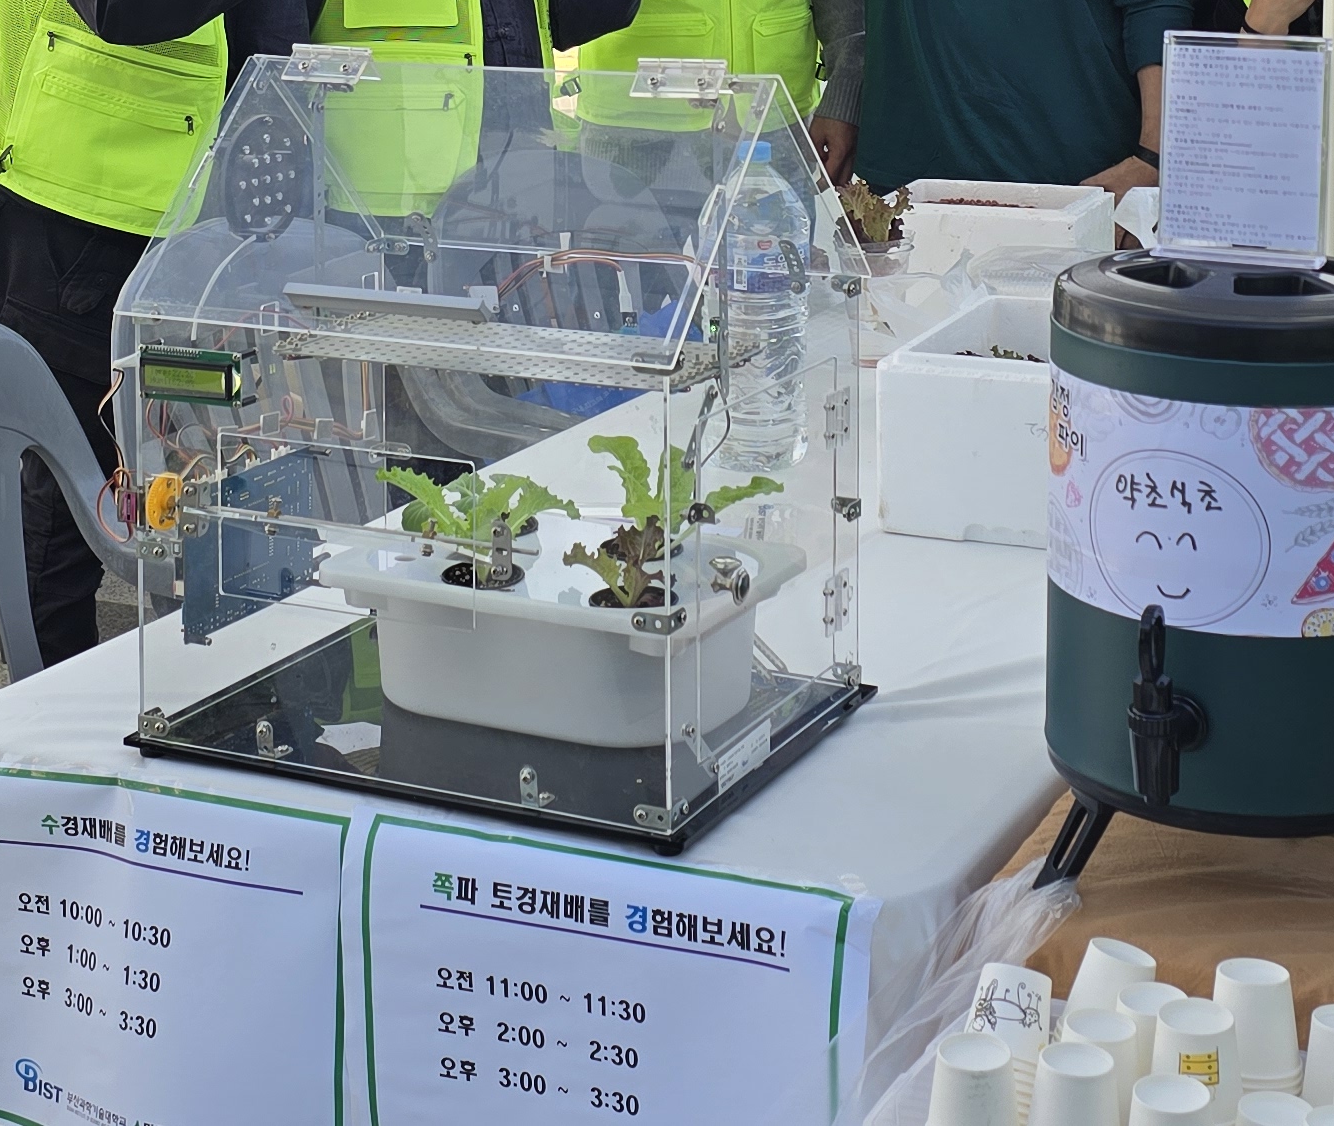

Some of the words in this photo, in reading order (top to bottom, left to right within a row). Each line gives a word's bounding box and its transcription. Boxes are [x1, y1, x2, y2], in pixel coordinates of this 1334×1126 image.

[1058, 422, 1085, 457] 파이
[1114, 472, 1224, 515] 약초식초
[40, 814, 127, 848] 수경재배를
[133, 828, 251, 872] 경험해보세요!
[17, 892, 51, 916] 오전
[59, 898, 103, 928] 10:00
[122, 918, 172, 949] 10:30
[431, 871, 479, 906] 쪽파
[489, 880, 611, 929] 토경재배를
[624, 903, 787, 959] 경험해보세요!
[19, 933, 52, 958] 오후
[67, 943, 97, 972] 1:00
[123, 965, 161, 993] 1:30
[21, 975, 52, 1001] 오후
[64, 987, 94, 1017] 3:00
[118, 1010, 158, 1039] 3:30
[435, 966, 475, 993] 오전
[485, 975, 549, 1005] 11:00
[583, 992, 647, 1024] 11:30
[437, 1011, 476, 1037] 오후
[496, 1021, 545, 1050] 2:00
[588, 1039, 640, 1070] 2:30
[17, 1059, 63, 1104] BIST
[439, 1056, 478, 1082] 오후
[497, 1066, 547, 1096] 3:00
[589, 1086, 640, 1117] 3:30
